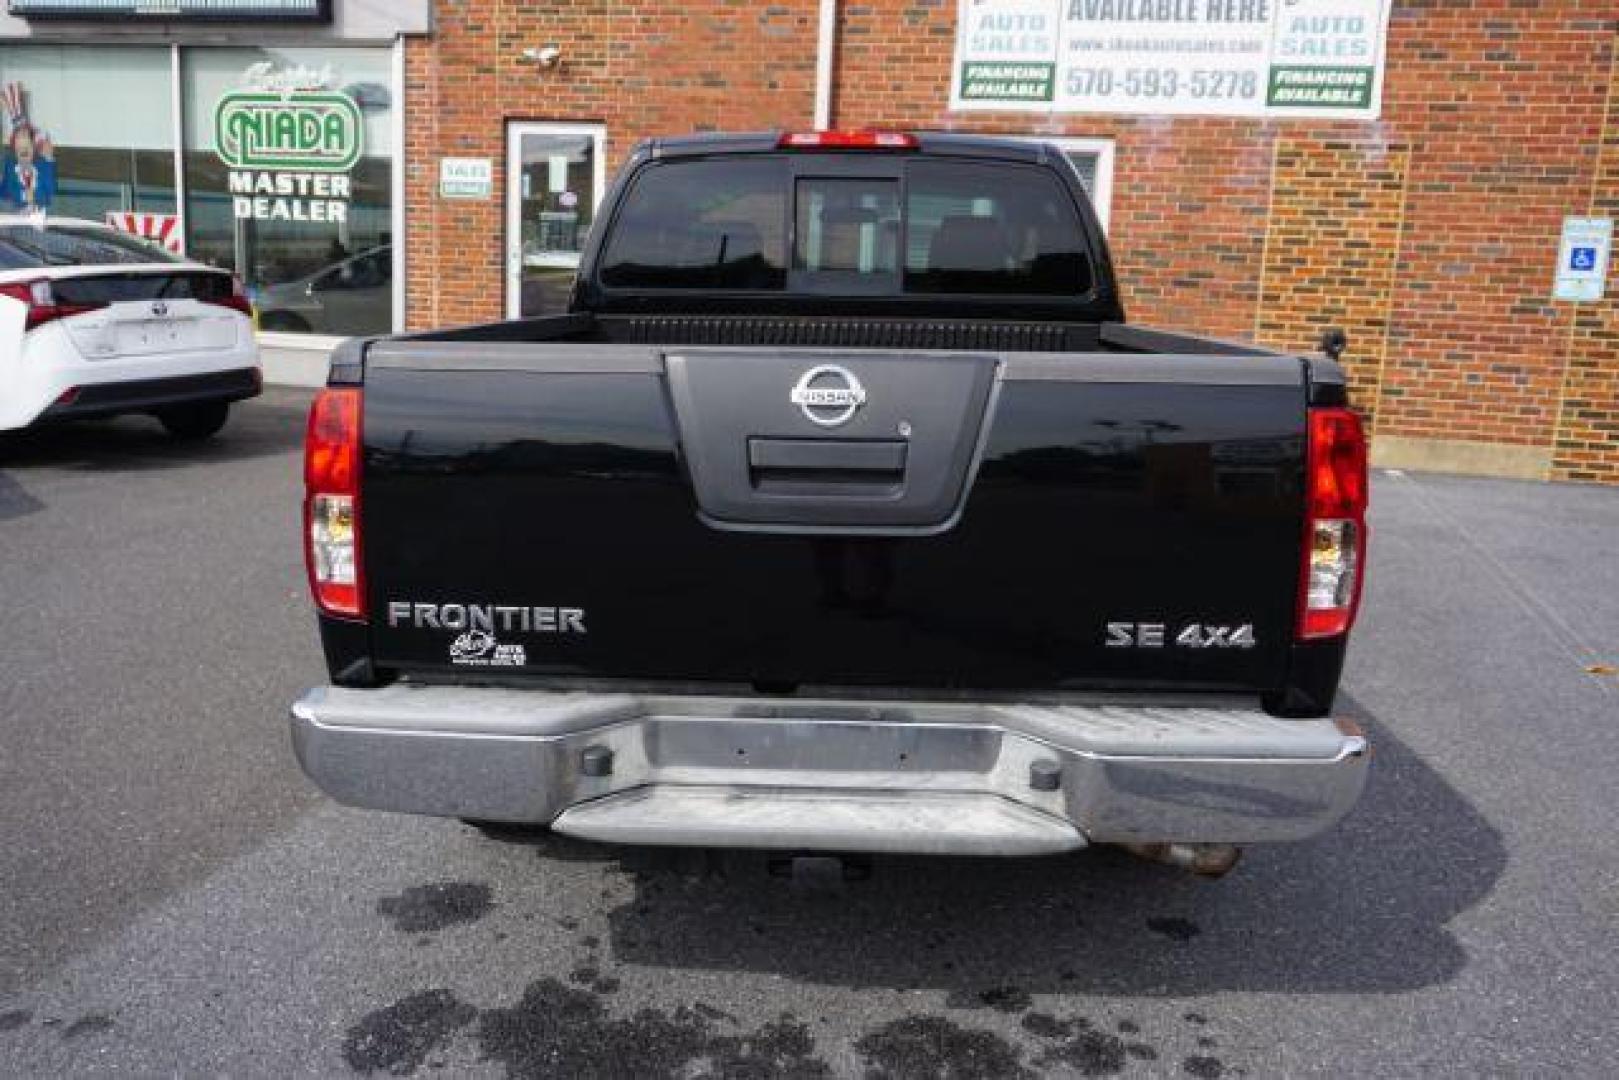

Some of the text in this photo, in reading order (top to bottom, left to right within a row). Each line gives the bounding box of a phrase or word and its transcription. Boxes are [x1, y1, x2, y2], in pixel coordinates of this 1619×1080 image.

[1067, 0, 1270, 23] AVAILABLE HERE
[979, 14, 1046, 31] AUTO
[1289, 15, 1364, 33] AUTO
[971, 34, 1050, 52] SALES
[1280, 37, 1368, 56] SALES
[965, 82, 1047, 97] AVAILABLE
[1067, 67, 1257, 99] 570-593-5278
[1273, 87, 1364, 102] AVAILABLE
[228, 171, 350, 197] MASTER
[233, 197, 346, 223] DEALER
[388, 601, 586, 633] FRONTIER
[1106, 621, 1165, 648] SE
